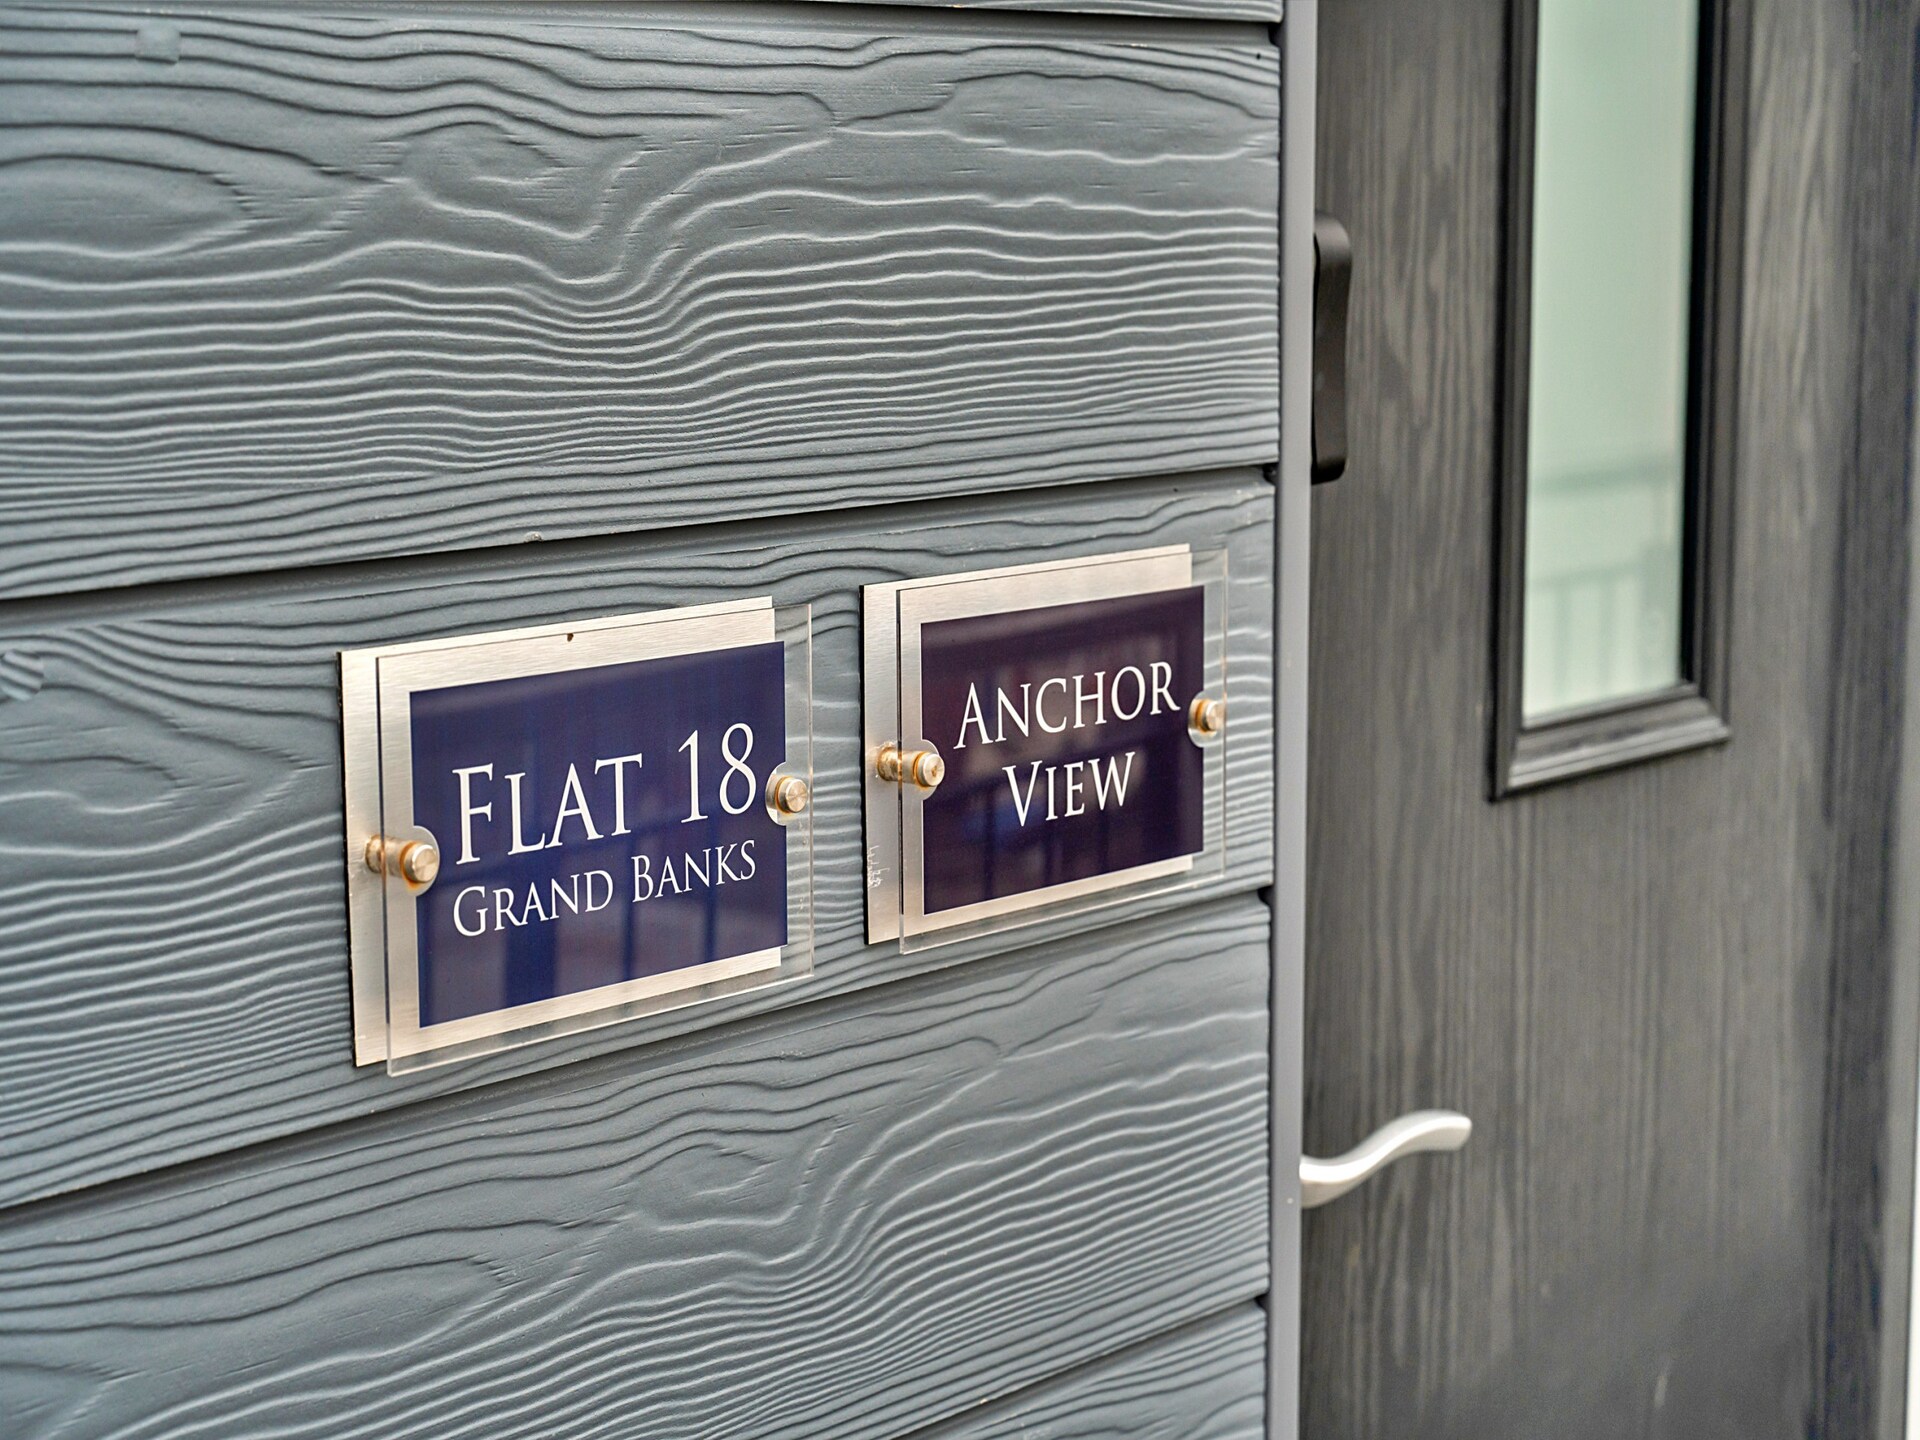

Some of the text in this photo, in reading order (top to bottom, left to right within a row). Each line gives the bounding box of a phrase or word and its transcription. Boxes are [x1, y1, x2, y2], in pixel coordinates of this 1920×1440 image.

[953, 661, 1181, 750] ANCHOR
[452, 722, 757, 865] FLAT 18
[1001, 751, 1136, 827] VIEW
[453, 839, 756, 937] GRAND BANKS
